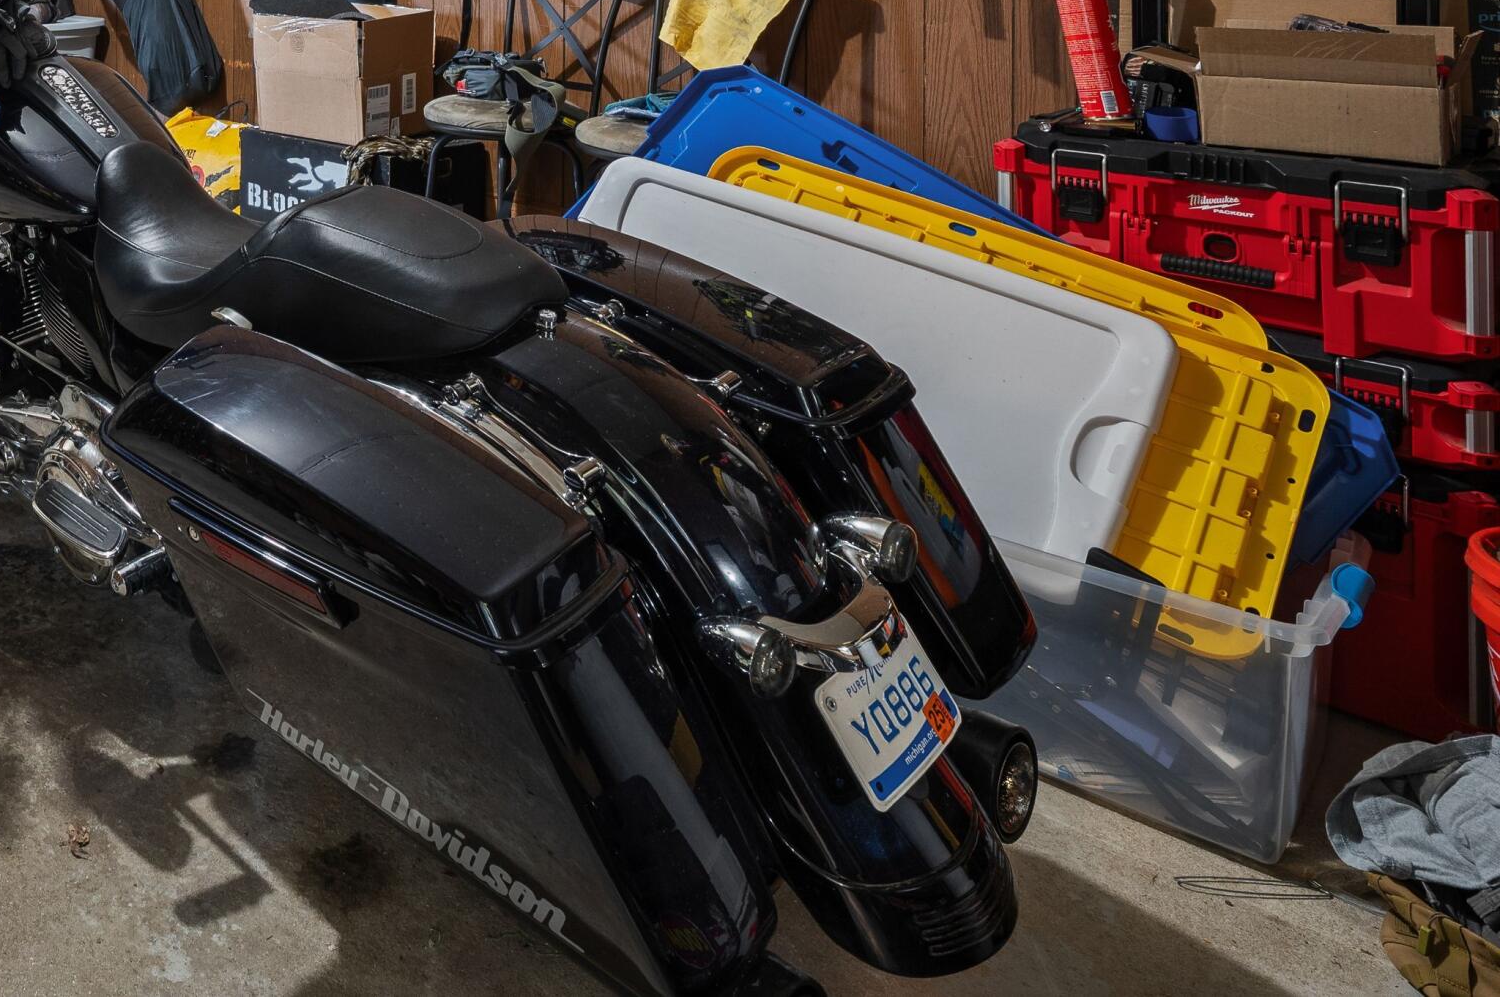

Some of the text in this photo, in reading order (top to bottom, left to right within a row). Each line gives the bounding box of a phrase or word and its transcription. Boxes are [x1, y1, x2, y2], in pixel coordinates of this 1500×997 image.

[1187, 194, 1240, 206] Milwaukee
[1213, 208, 1255, 218] PACKOUT
[846, 677, 867, 698] PURE
[904, 728, 938, 765] michigan.org
